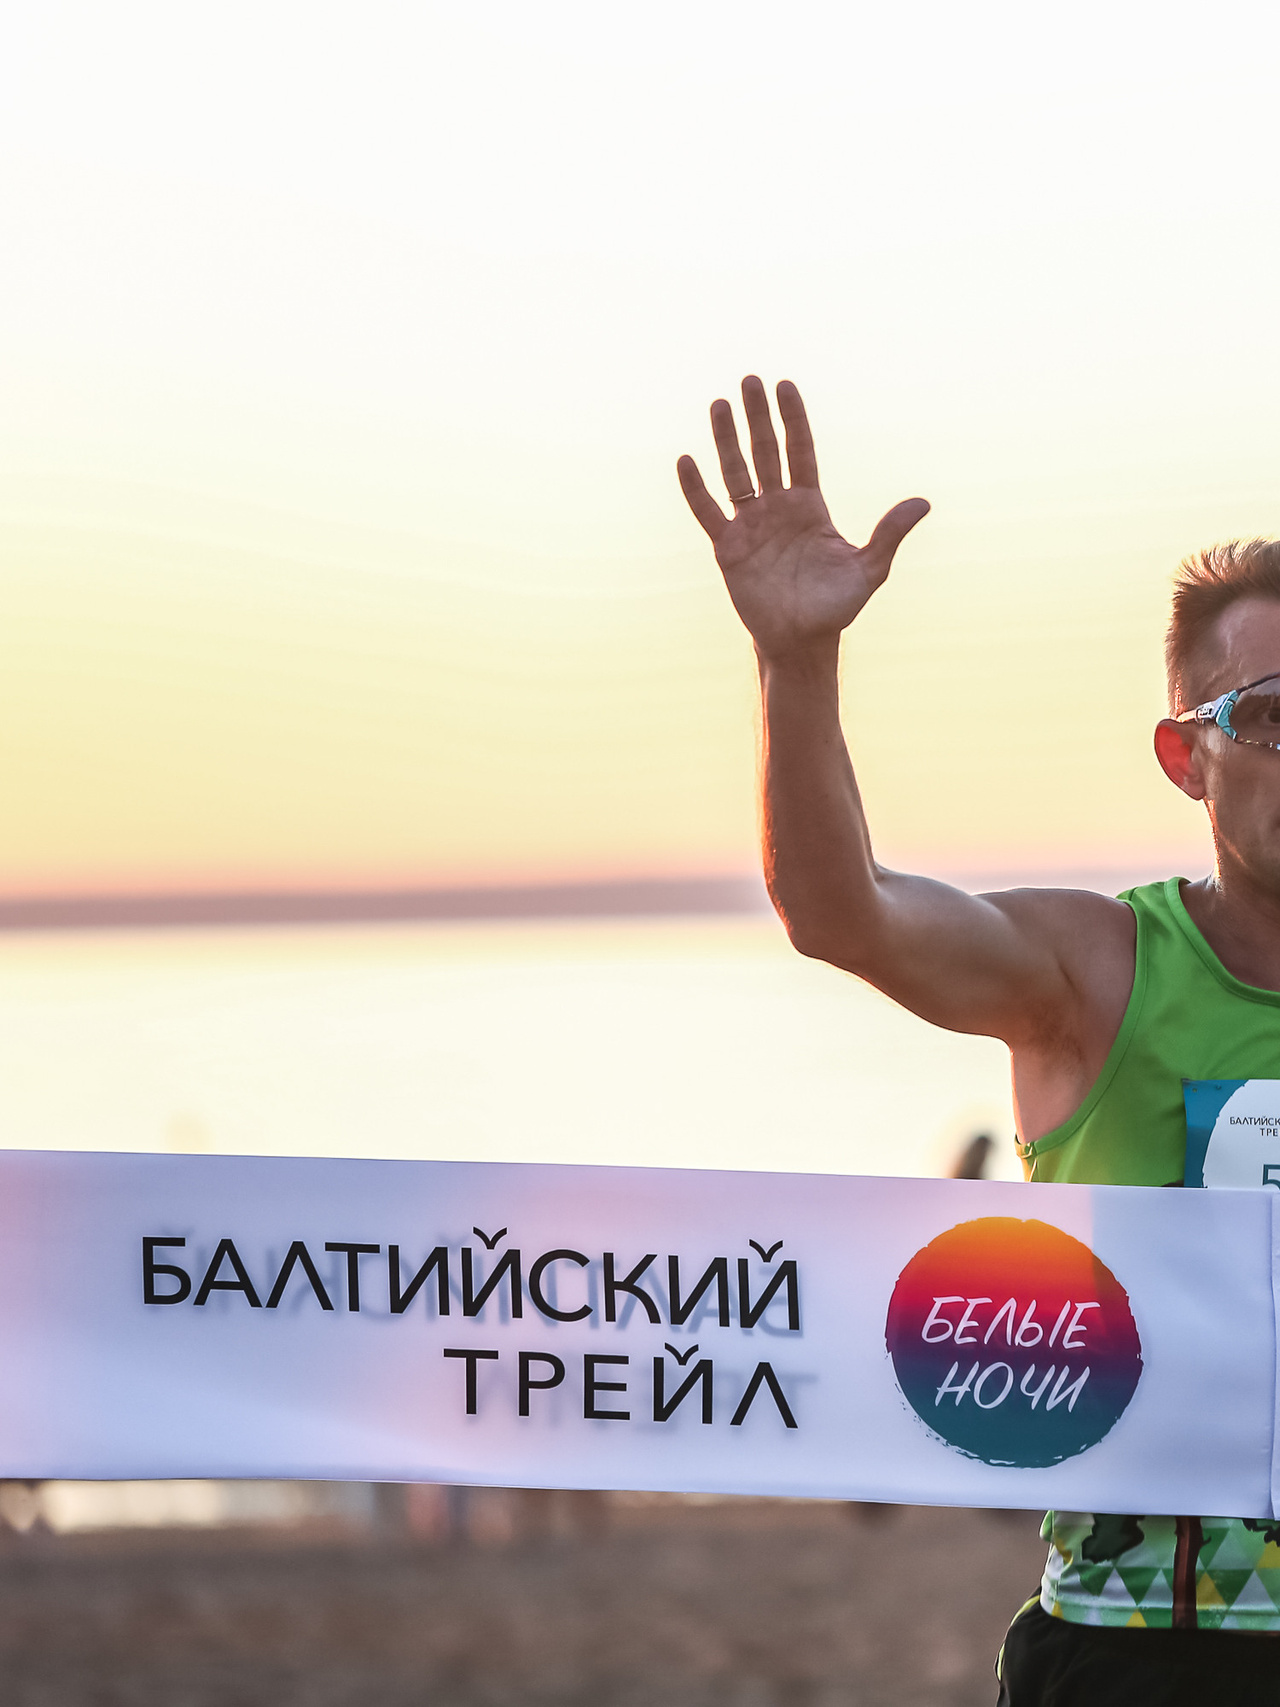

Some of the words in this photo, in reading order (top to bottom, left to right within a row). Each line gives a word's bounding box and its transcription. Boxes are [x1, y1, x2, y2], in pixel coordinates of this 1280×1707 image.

[142, 1227, 800, 1330] БАЛТИЙСКИЙ
[921, 1296, 1100, 1349] БЕЛЫЕ
[443, 1342, 799, 1429] ТРЕЙЛ
[935, 1361, 1091, 1413] НОЧИ
